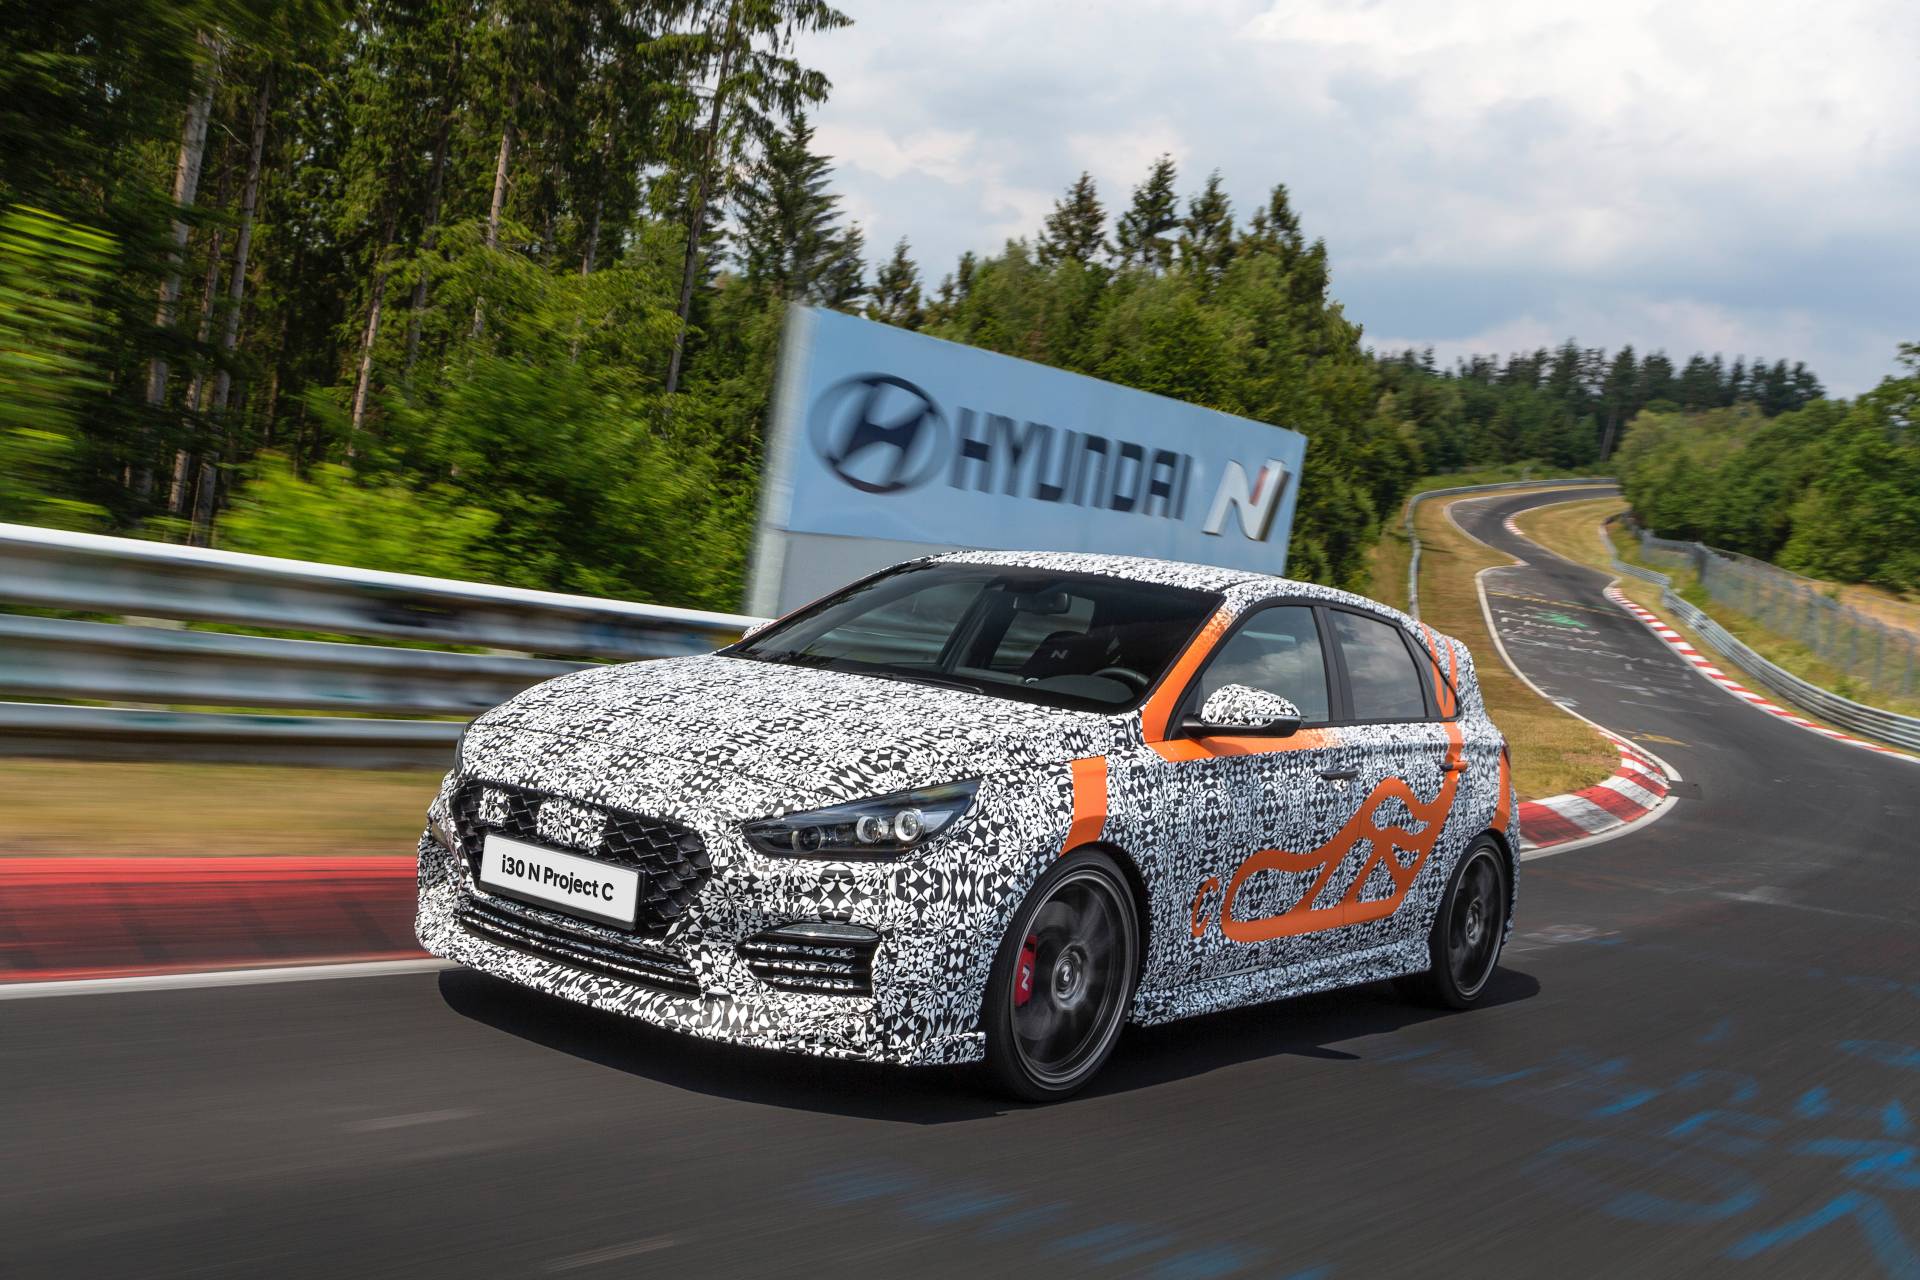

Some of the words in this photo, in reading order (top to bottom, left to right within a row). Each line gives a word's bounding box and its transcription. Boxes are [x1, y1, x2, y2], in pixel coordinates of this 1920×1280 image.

[949, 406, 1194, 521] HYUNDAI
[1202, 458, 1291, 542] N
[501, 854, 525, 878] i30
[528, 862, 541, 882] N
[543, 866, 599, 898] Project
[601, 882, 615, 902] C
